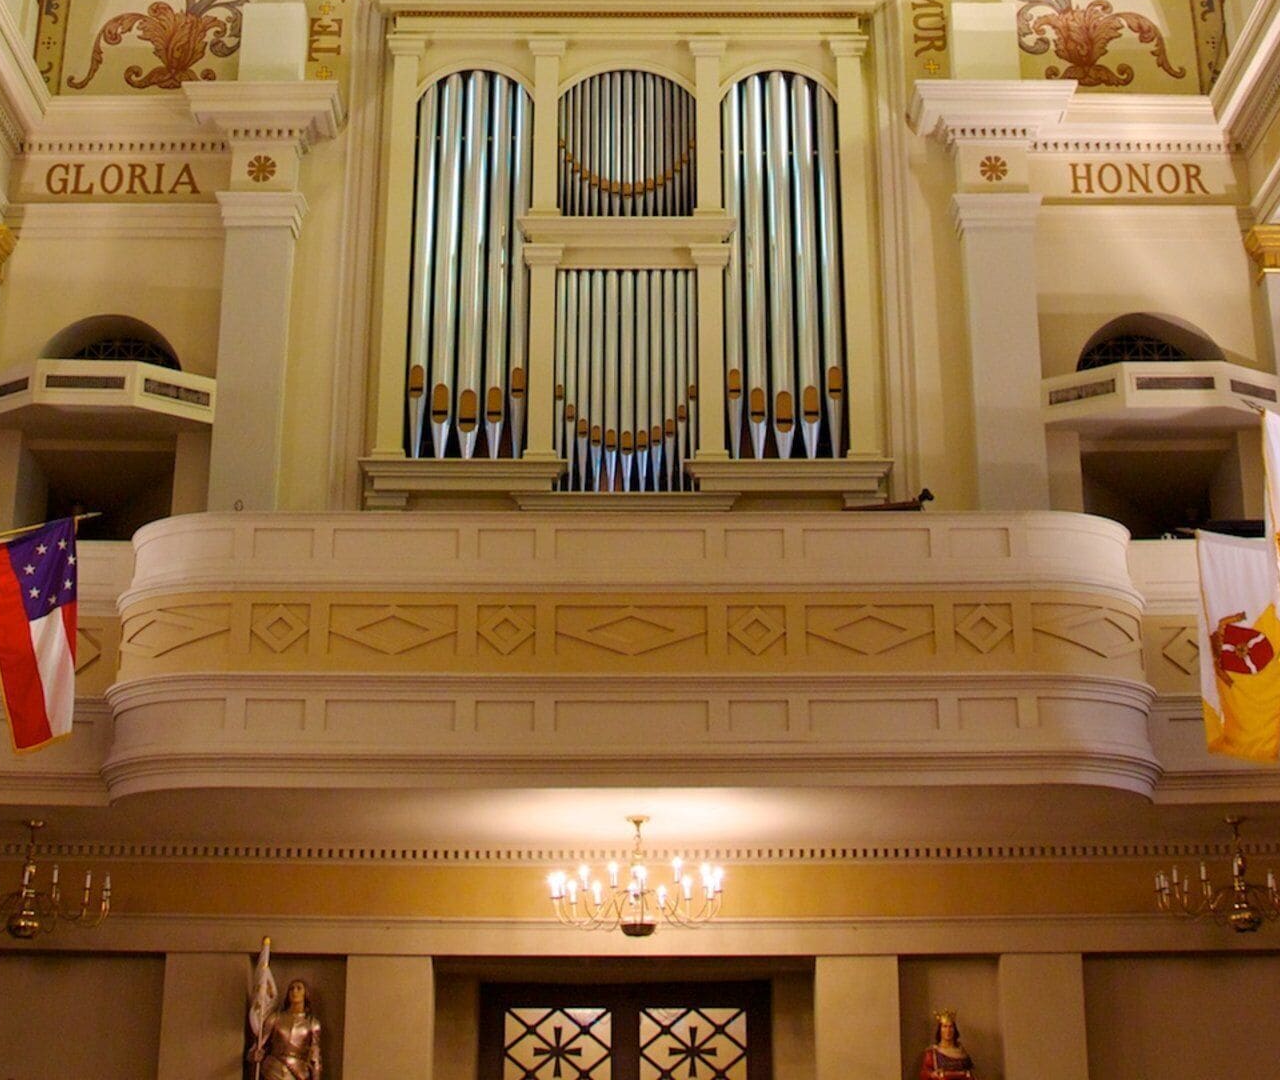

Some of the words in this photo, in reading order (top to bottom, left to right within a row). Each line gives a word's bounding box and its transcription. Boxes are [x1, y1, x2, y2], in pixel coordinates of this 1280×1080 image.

[307, 17, 343, 63] TE
[45, 162, 201, 195] GLORIA
[1068, 162, 1210, 195] HONOR
